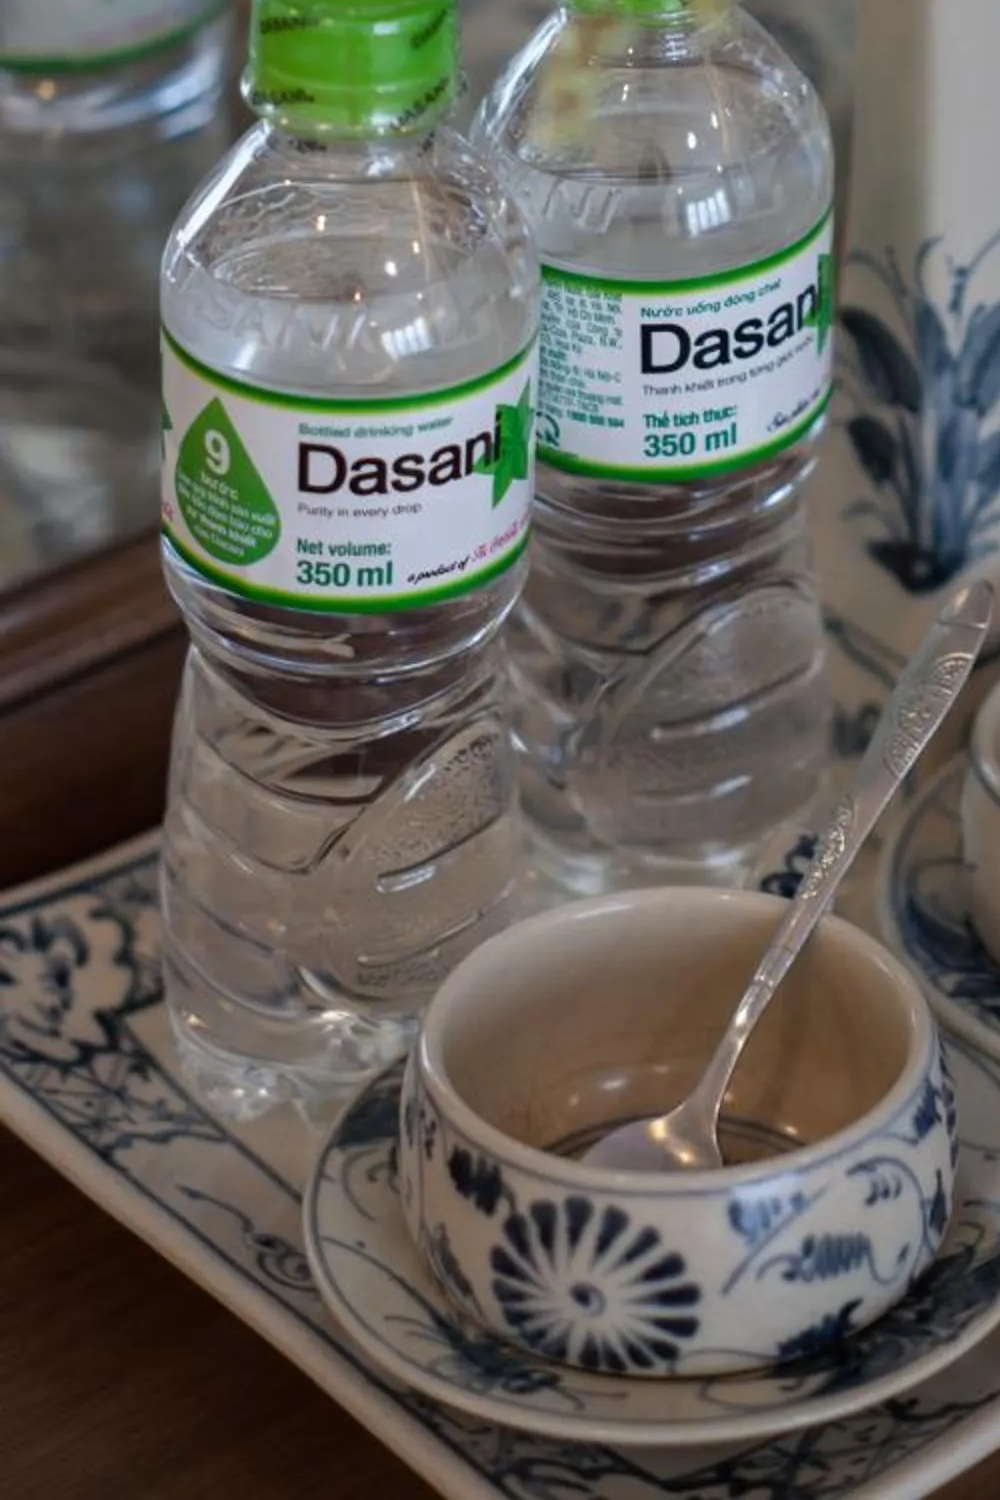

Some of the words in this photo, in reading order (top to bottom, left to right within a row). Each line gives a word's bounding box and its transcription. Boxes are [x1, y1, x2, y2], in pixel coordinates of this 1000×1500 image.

[298, 422, 352, 438] Bottled
[353, 422, 415, 439] drinking
[416, 416, 455, 434] water
[643, 431, 696, 458] 350
[704, 422, 737, 452] ml
[203, 428, 231, 476] 9
[298, 409, 502, 496] Dasani
[297, 502, 334, 519] Purity
[337, 503, 349, 517] in
[351, 504, 389, 519] every
[391, 501, 423, 516] drop
[297, 537, 323, 556] Net
[327, 540, 393, 557] volume:
[296, 559, 351, 587] 350
[356, 561, 394, 587] ml
